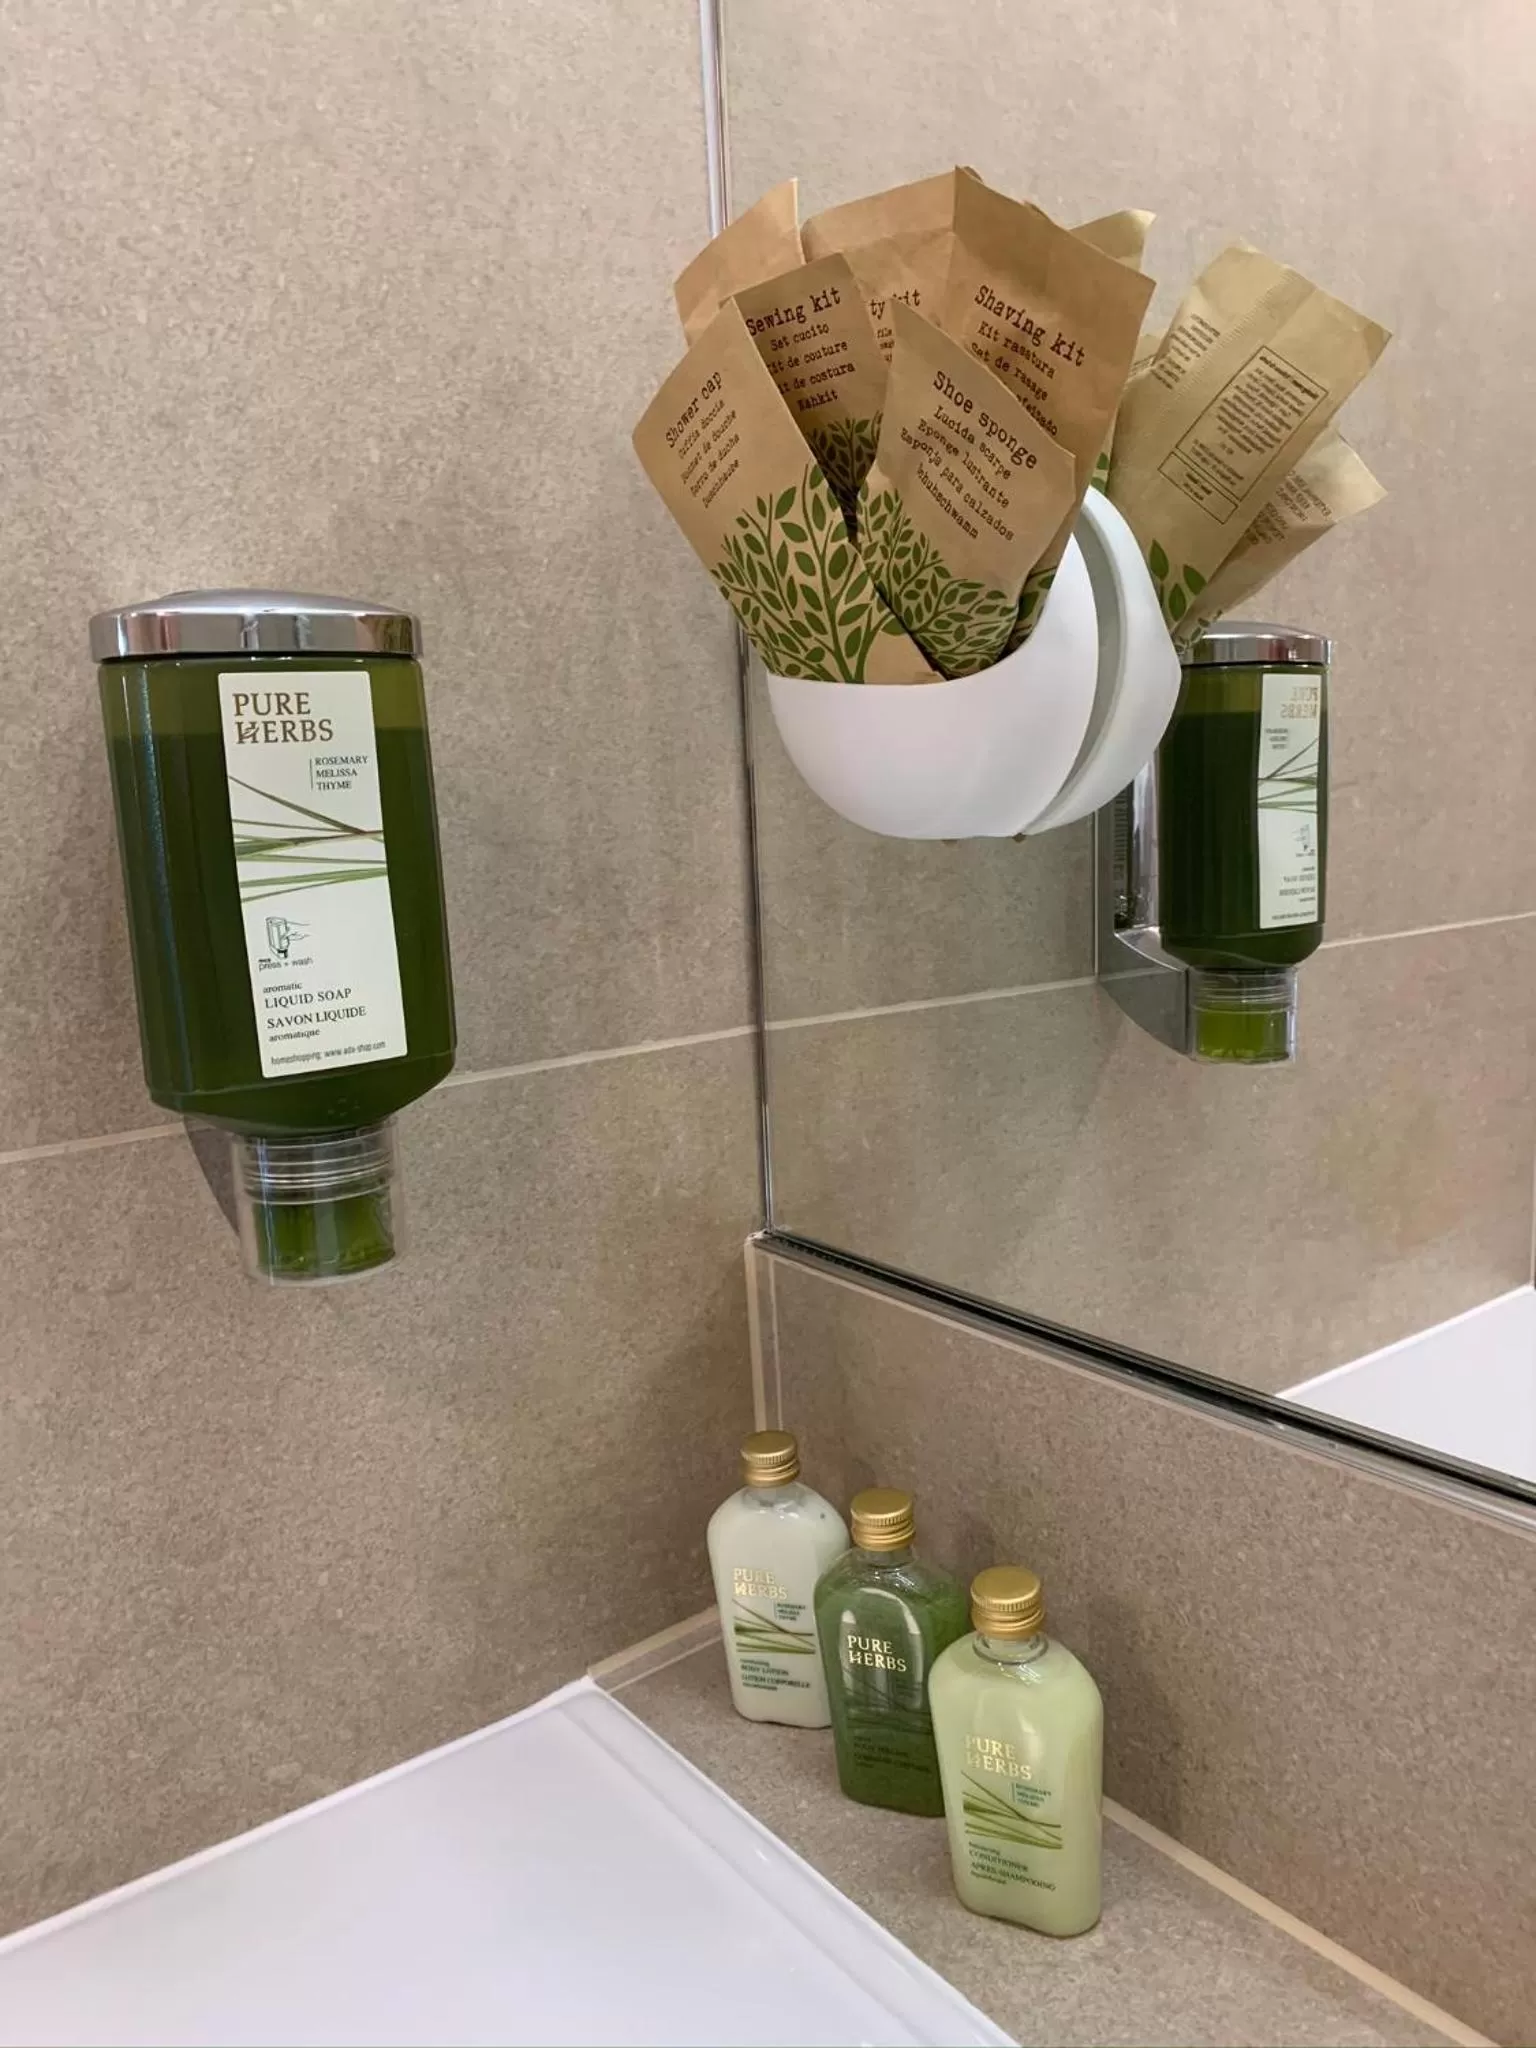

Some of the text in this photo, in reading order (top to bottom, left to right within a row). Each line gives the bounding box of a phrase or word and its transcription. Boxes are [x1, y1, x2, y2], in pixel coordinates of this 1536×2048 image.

[745, 303, 807, 337] Sewing
[809, 286, 841, 313] kit
[770, 322, 830, 351] Set cucito
[974, 284, 1085, 367] Shaving kit
[976, 321, 1000, 342] Kit
[787, 355, 800, 369] de
[804, 340, 848, 364] couture
[809, 362, 856, 386] costura
[665, 372, 722, 448] Shower cap
[932, 369, 1038, 470] Shoe sponge
[933, 404, 1012, 481] Lucida scarpe
[900, 426, 1016, 542] Esponja para calzados
[961, 451, 1011, 508] lustrante
[232, 691, 312, 717] PURE
[235, 718, 335, 745] HERBS
[314, 755, 369, 767] ROSEMARY
[315, 768, 359, 779] MELISSA
[316, 780, 353, 791] THYME
[262, 982, 304, 995] aromatic
[263, 987, 353, 1010] LIQUID SOAP
[266, 1004, 367, 1030] SAVON LIQUIDE
[268, 1028, 321, 1044] aromatique
[732, 1567, 776, 1584] PURE
[733, 1581, 789, 1601] HERBS
[847, 1635, 893, 1655] PURE
[848, 1650, 908, 1673] HERBS
[964, 1734, 1017, 1761] PURE
[965, 1751, 1033, 1781] HERBS
